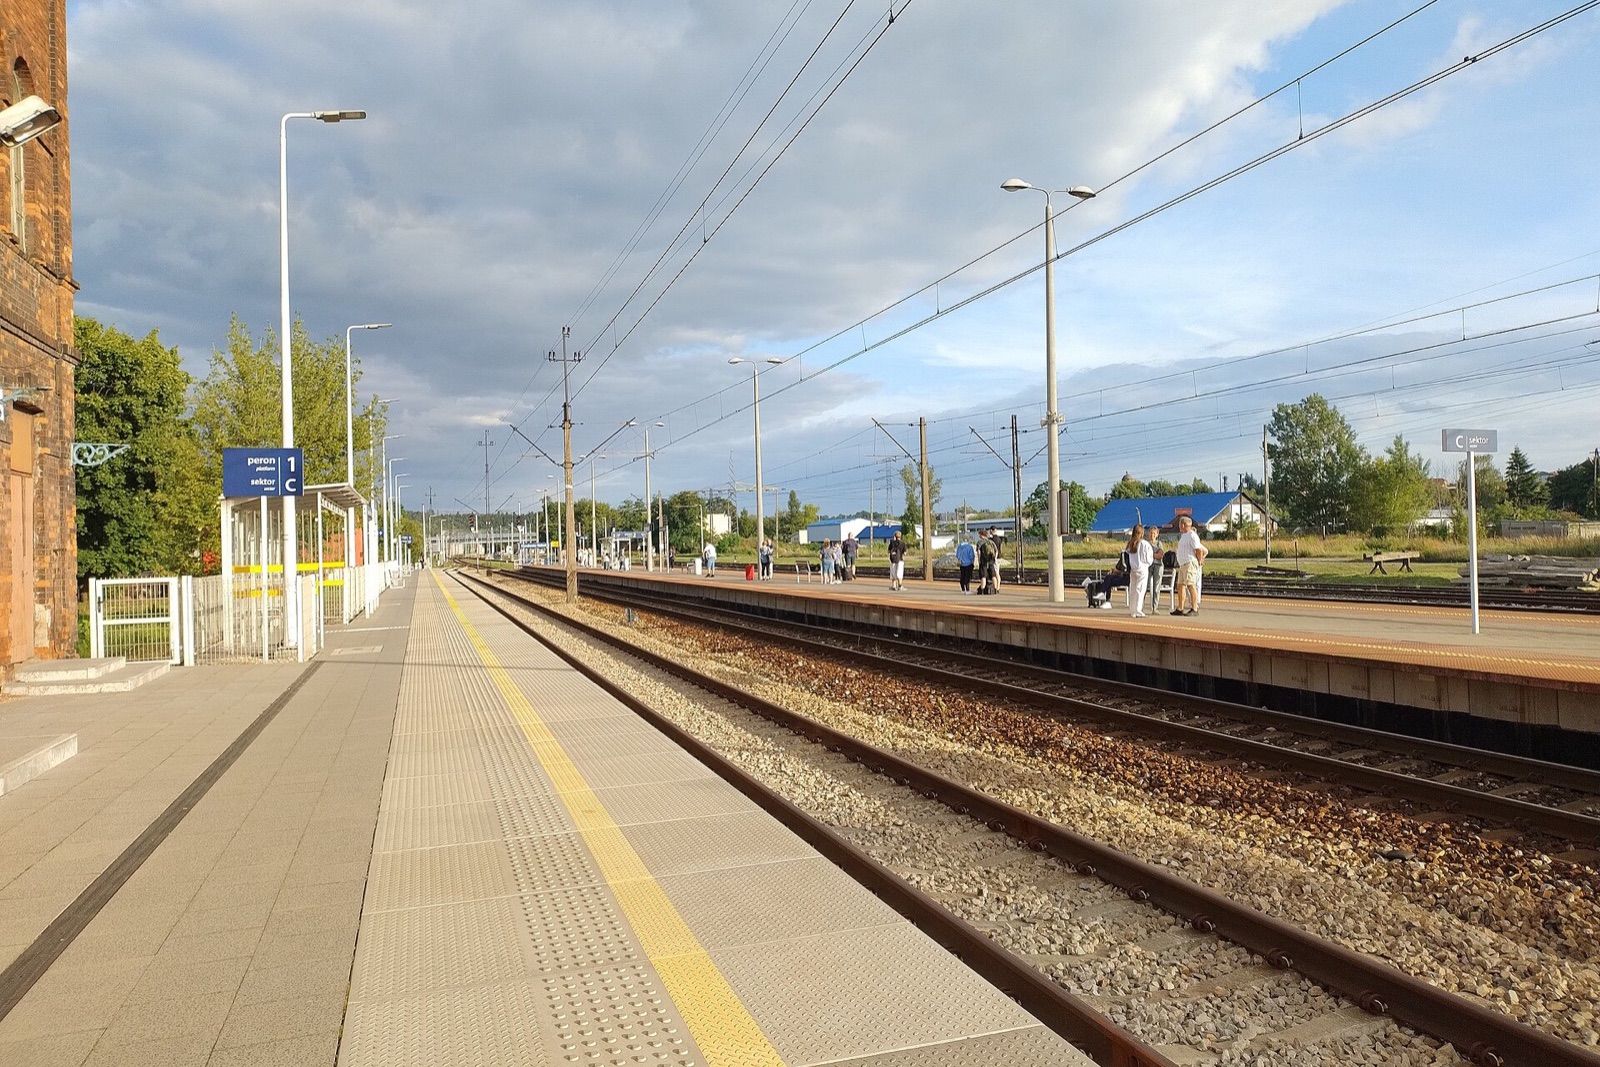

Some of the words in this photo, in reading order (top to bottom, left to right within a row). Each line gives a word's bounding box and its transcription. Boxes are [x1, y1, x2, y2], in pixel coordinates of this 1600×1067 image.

[1456, 435, 1463, 448] C
[1469, 436, 1488, 444] sektor
[247, 457, 275, 466] peron
[287, 457, 295, 472] 1
[285, 478, 296, 491] C
